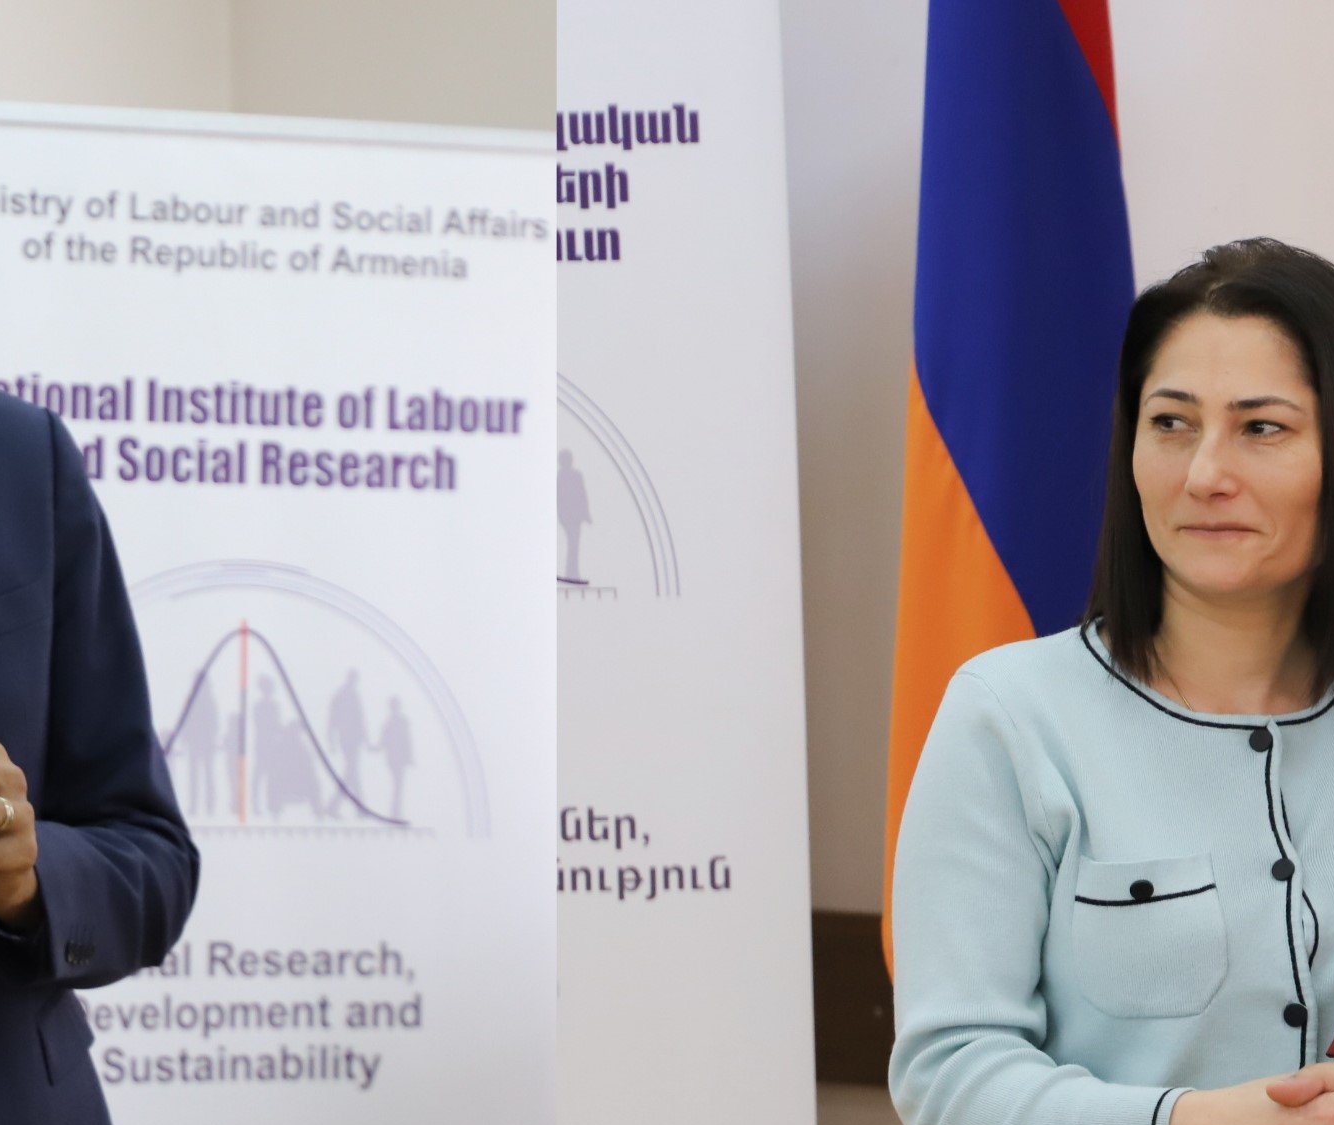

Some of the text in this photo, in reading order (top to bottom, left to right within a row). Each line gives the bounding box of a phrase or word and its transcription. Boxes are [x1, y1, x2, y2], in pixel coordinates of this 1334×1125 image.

[85, 190, 119, 219] of
[130, 192, 247, 226] Labour
[259, 200, 321, 229] and
[332, 201, 432, 236] Social
[442, 207, 550, 241] Affairs
[21, 231, 469, 280] of the Republic of Armenia
[146, 376, 323, 429] Institute
[337, 385, 375, 430] of
[388, 385, 526, 435] Labour
[117, 435, 247, 485] Social
[260, 440, 457, 491] Research
[207, 940, 416, 982] Research,
[345, 994, 424, 1030] and
[102, 1045, 381, 1091] Sustainability
